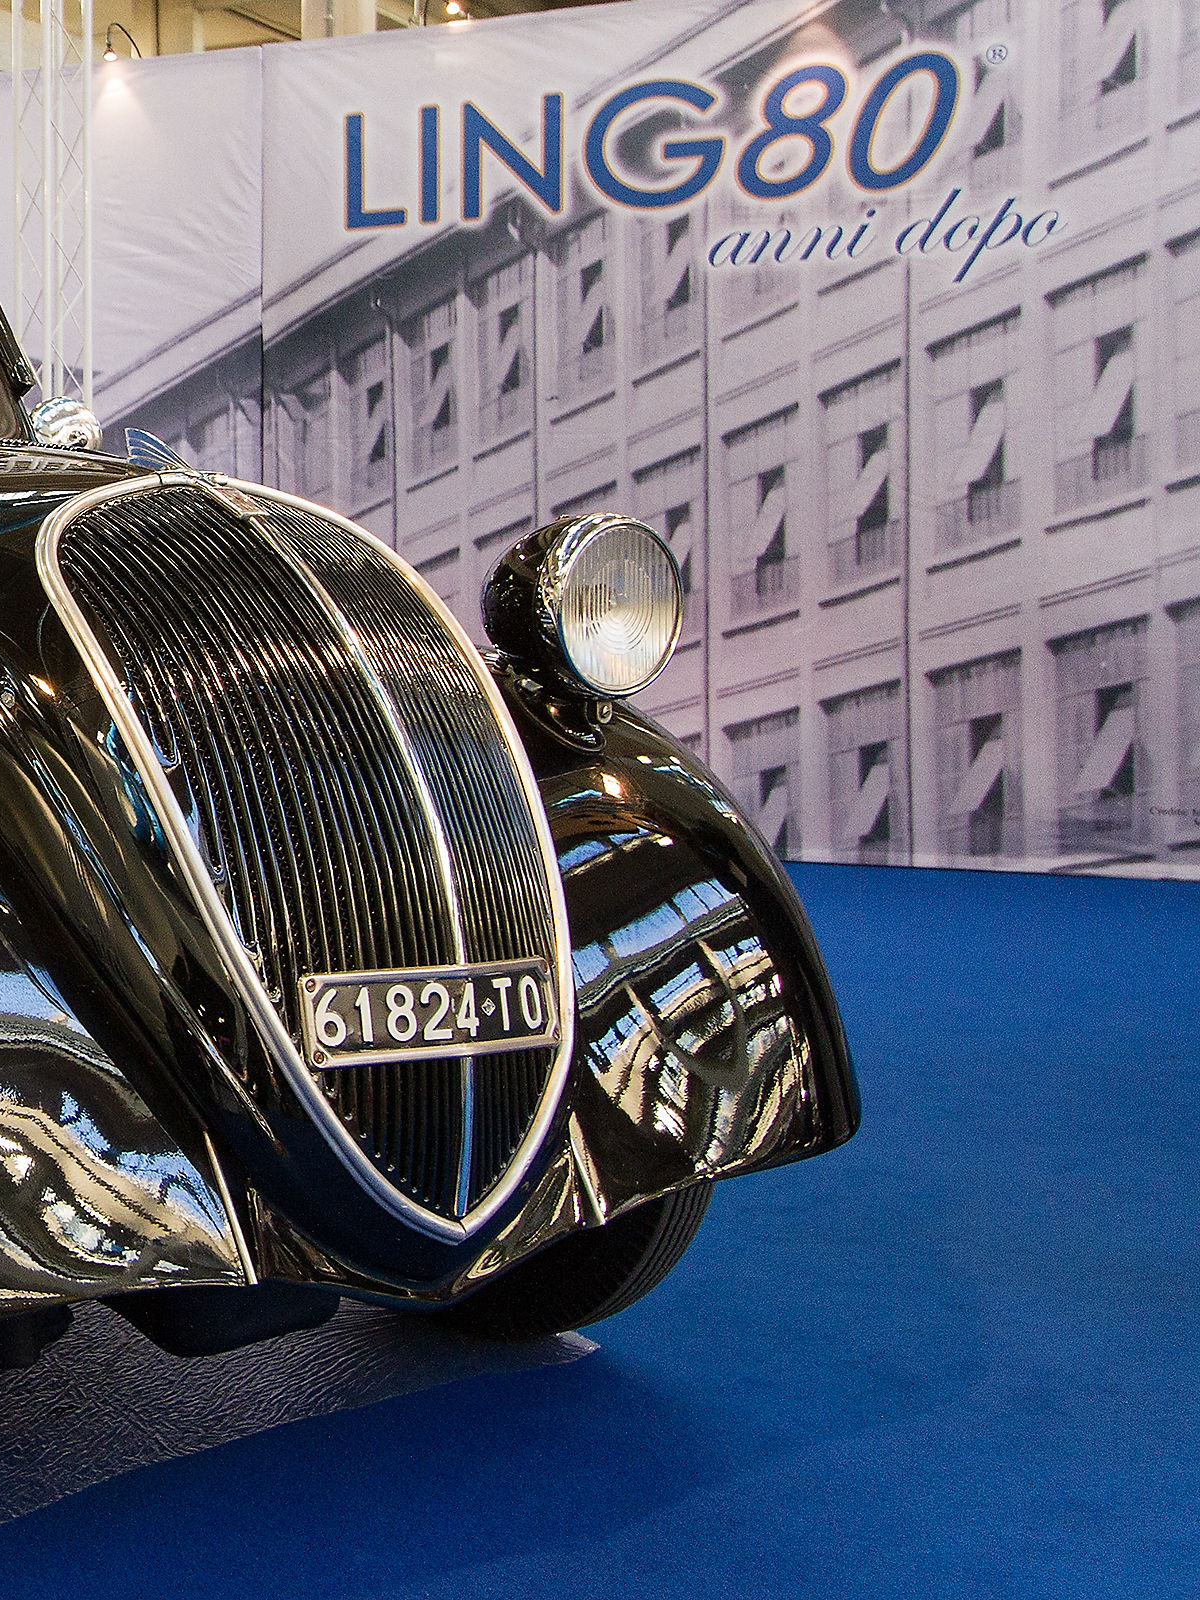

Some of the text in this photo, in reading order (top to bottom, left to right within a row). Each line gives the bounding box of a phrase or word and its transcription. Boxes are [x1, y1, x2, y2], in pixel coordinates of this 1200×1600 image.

[345, 49, 961, 231] LING80
[707, 187, 1067, 283] anni dopo
[315, 982, 480, 1047] 61824
